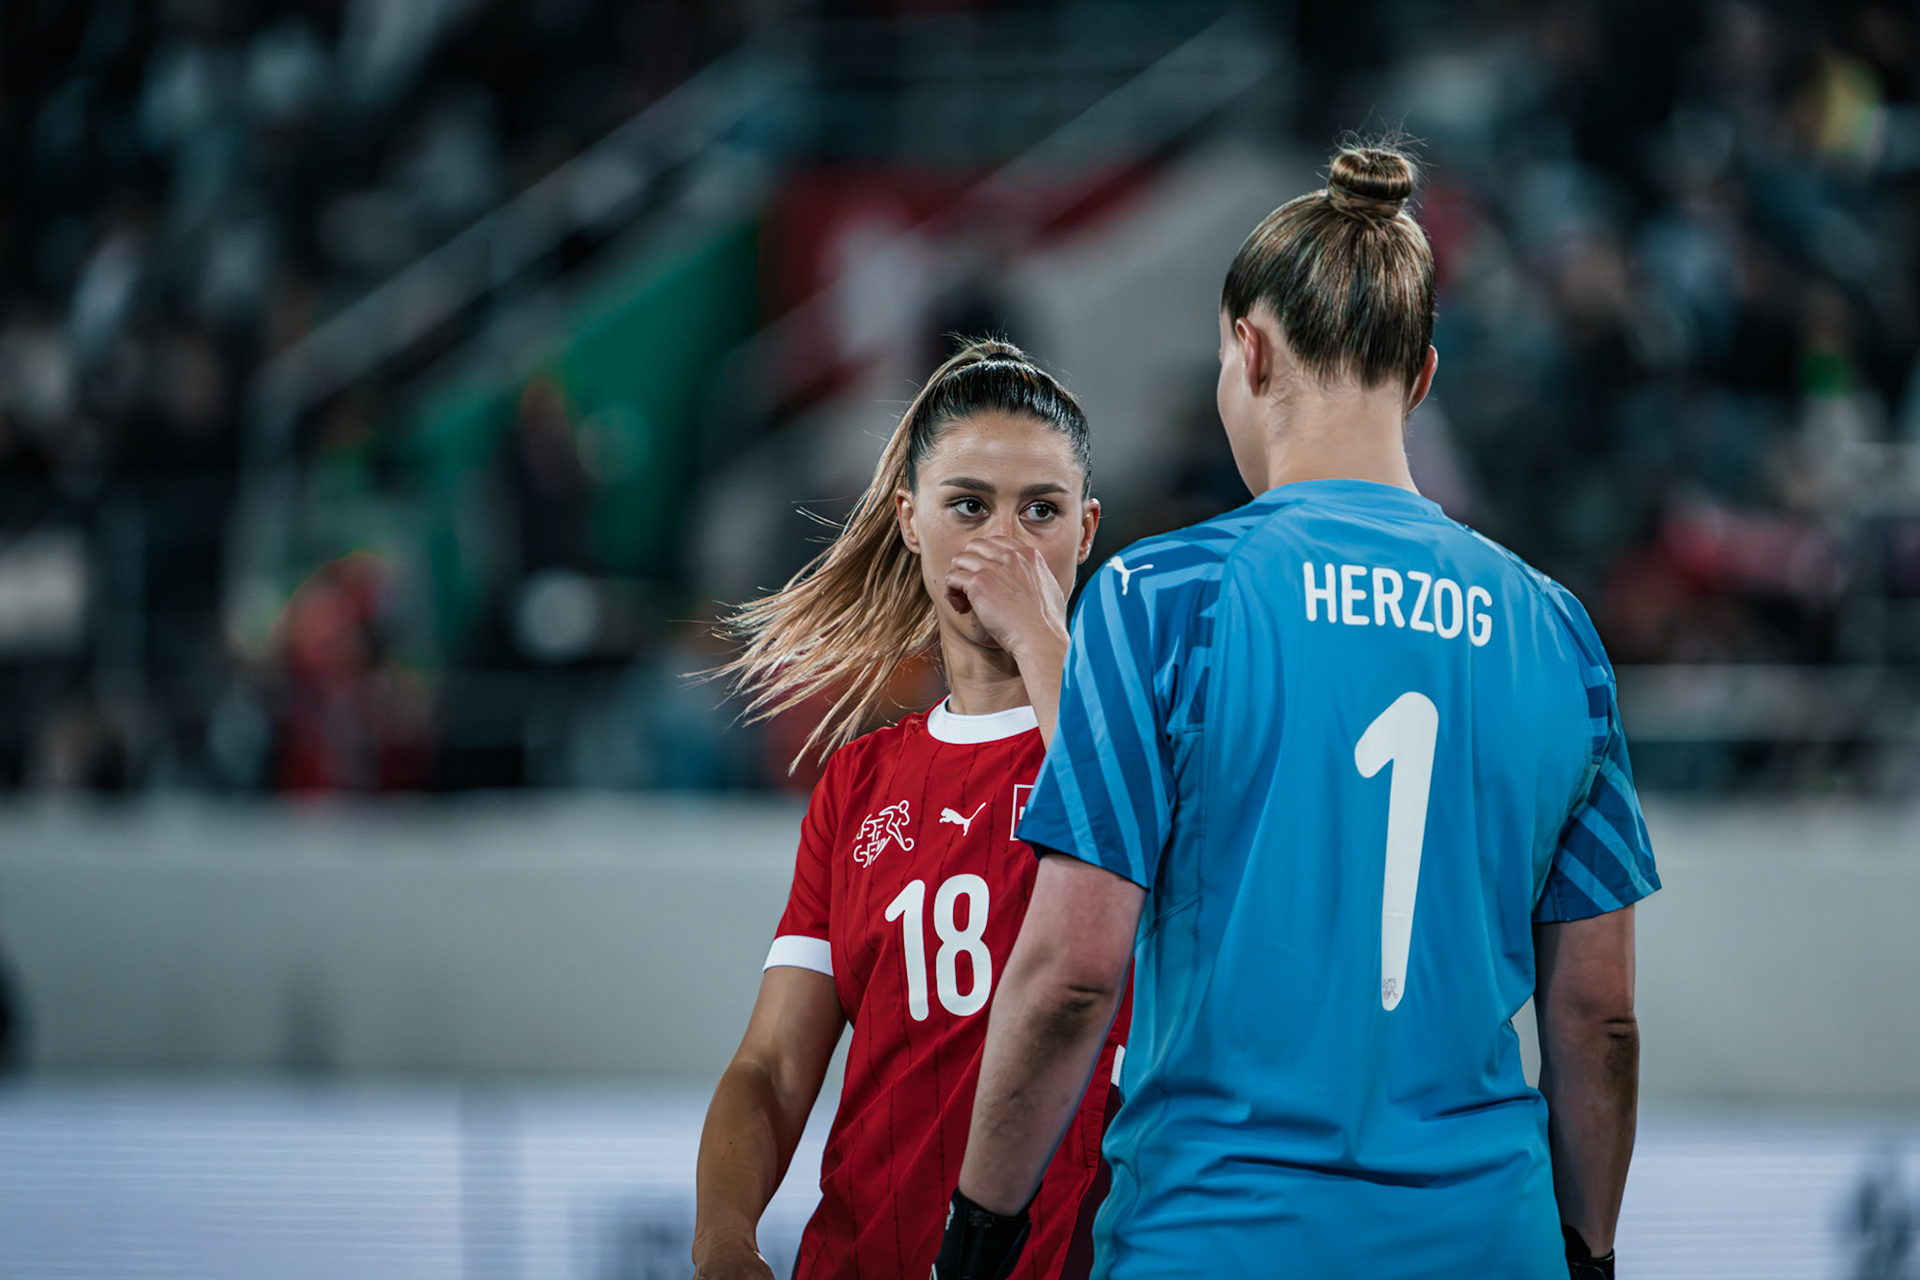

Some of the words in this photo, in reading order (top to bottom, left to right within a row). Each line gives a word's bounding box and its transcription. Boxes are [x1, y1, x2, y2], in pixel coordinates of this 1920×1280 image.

[1303, 561, 1493, 647] HERZOG
[1354, 691, 1439, 1011] 1
[884, 873, 993, 1021] 18
